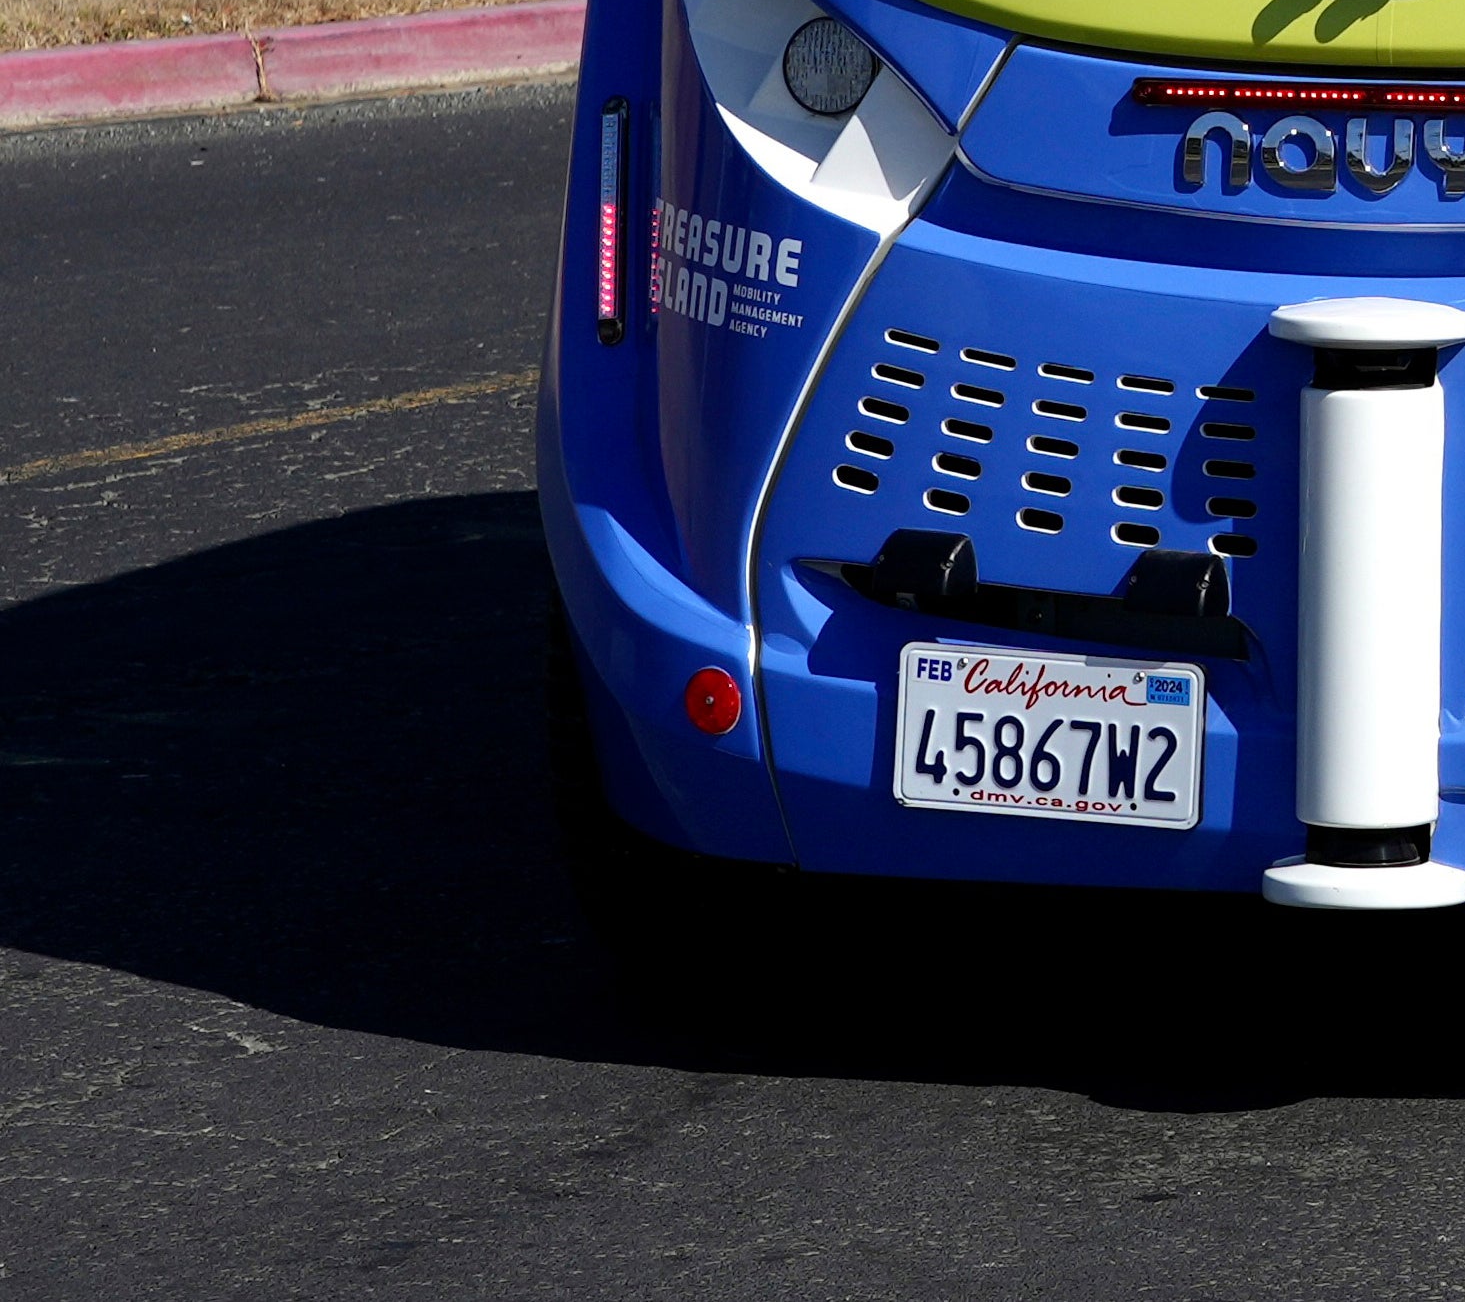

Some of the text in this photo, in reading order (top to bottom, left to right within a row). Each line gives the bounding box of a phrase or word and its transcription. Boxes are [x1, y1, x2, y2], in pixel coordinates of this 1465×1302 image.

[655, 196, 803, 288] TREASURE
[648, 256, 729, 328] ISLAND
[732, 283, 782, 306] MOBILITY
[728, 318, 768, 339] AGENCY
[730, 300, 804, 329] MANAGEMENT
[916, 657, 1183, 710] FEB California 2024
[915, 708, 1179, 803] 45867W2
[970, 788, 1122, 814] dmv.ca.gov
